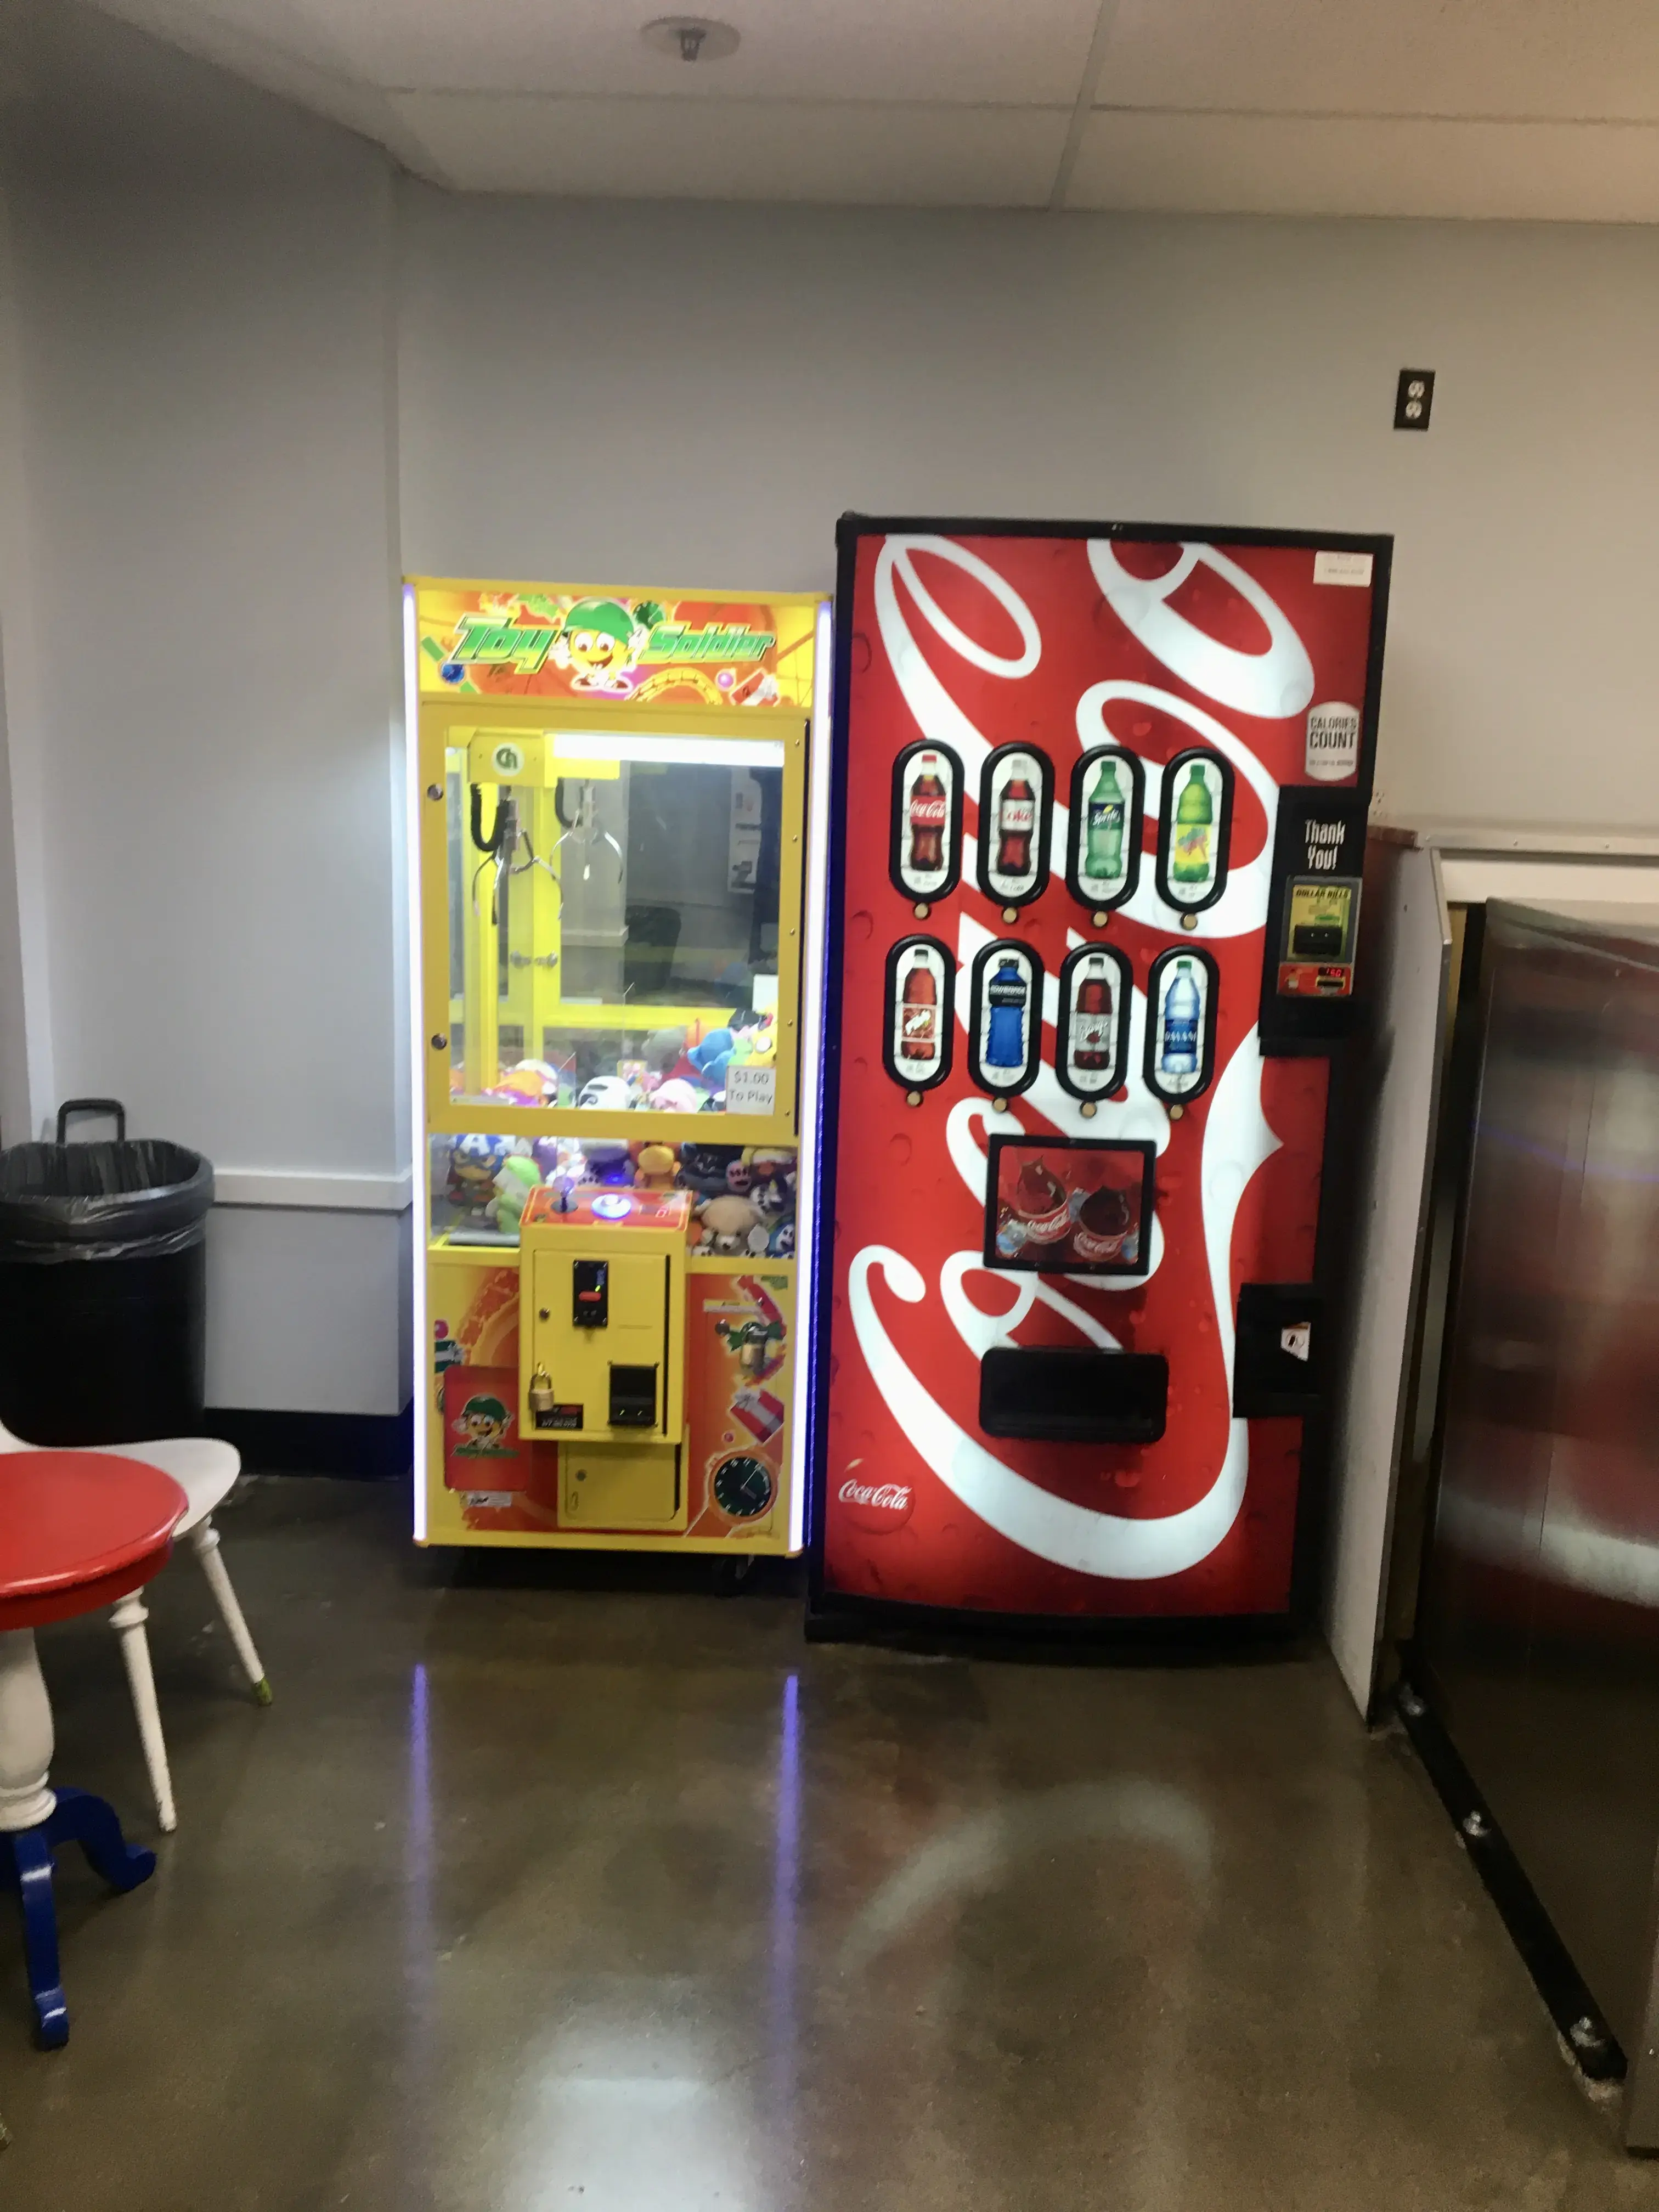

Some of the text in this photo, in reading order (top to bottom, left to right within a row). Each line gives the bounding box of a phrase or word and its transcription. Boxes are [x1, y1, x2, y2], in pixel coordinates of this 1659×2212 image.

[447, 614, 776, 675] Toy Soldier
[1311, 716, 1357, 729] CALORIES
[1310, 731, 1356, 749] COUNT
[1092, 808, 1120, 826] Sprite
[1305, 819, 1346, 845] Thank
[1307, 844, 1339, 870] You!
[1296, 889, 1350, 900] DOLLAR BILLS
[734, 1070, 770, 1085] $1.00
[729, 1088, 773, 1105] To Play
[838, 1479, 912, 1510] Coca-Cola
